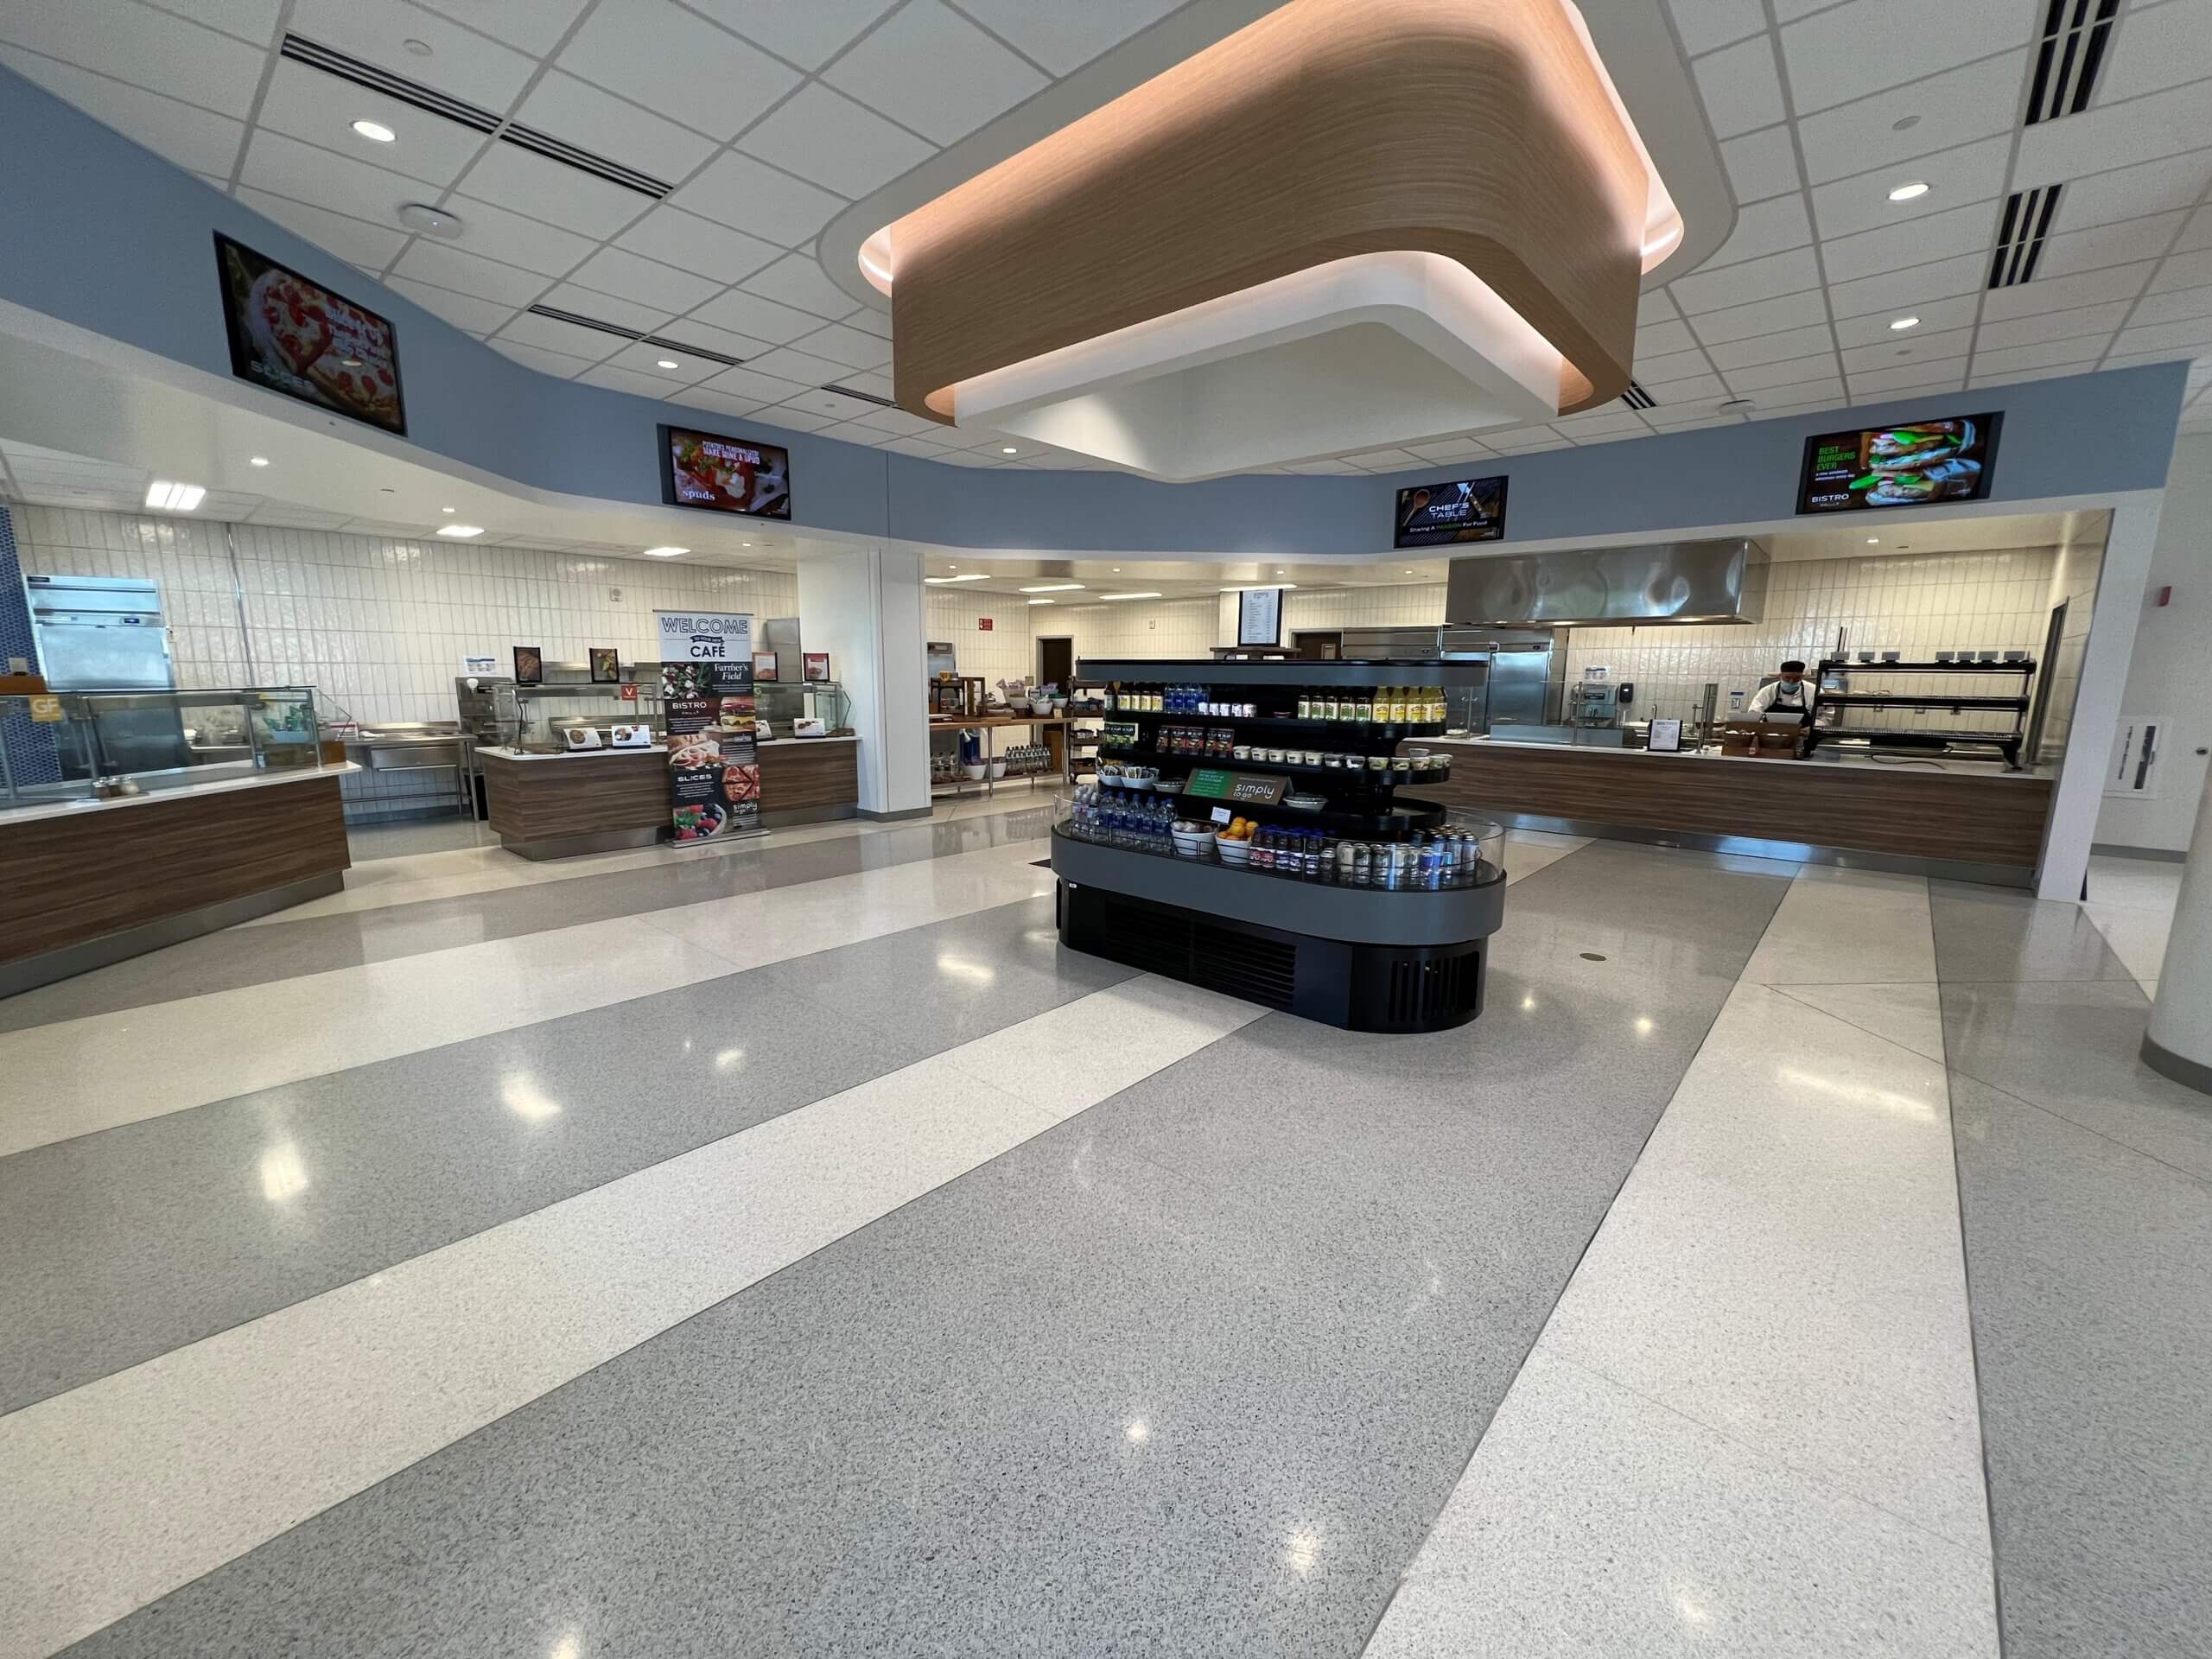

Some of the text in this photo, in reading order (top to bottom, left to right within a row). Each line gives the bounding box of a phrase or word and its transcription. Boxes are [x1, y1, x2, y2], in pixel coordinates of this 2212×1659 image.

[1819, 446, 1839, 454] BEST
[1817, 452, 1856, 463] BURGERS
[683, 490, 715, 500] spuds
[1811, 493, 1849, 502] BISTRO
[1429, 503, 1469, 512] CHEF'S
[1430, 510, 1467, 518] TABLE
[661, 617, 748, 634] WELCOME
[690, 642, 725, 658] CAFÉ
[714, 664, 748, 672] Farmer's
[721, 671, 741, 680] Field
[33, 698, 58, 714] GF
[677, 773, 712, 782] SLICES
[1235, 784, 1274, 799] simply
[733, 801, 758, 810] simply
